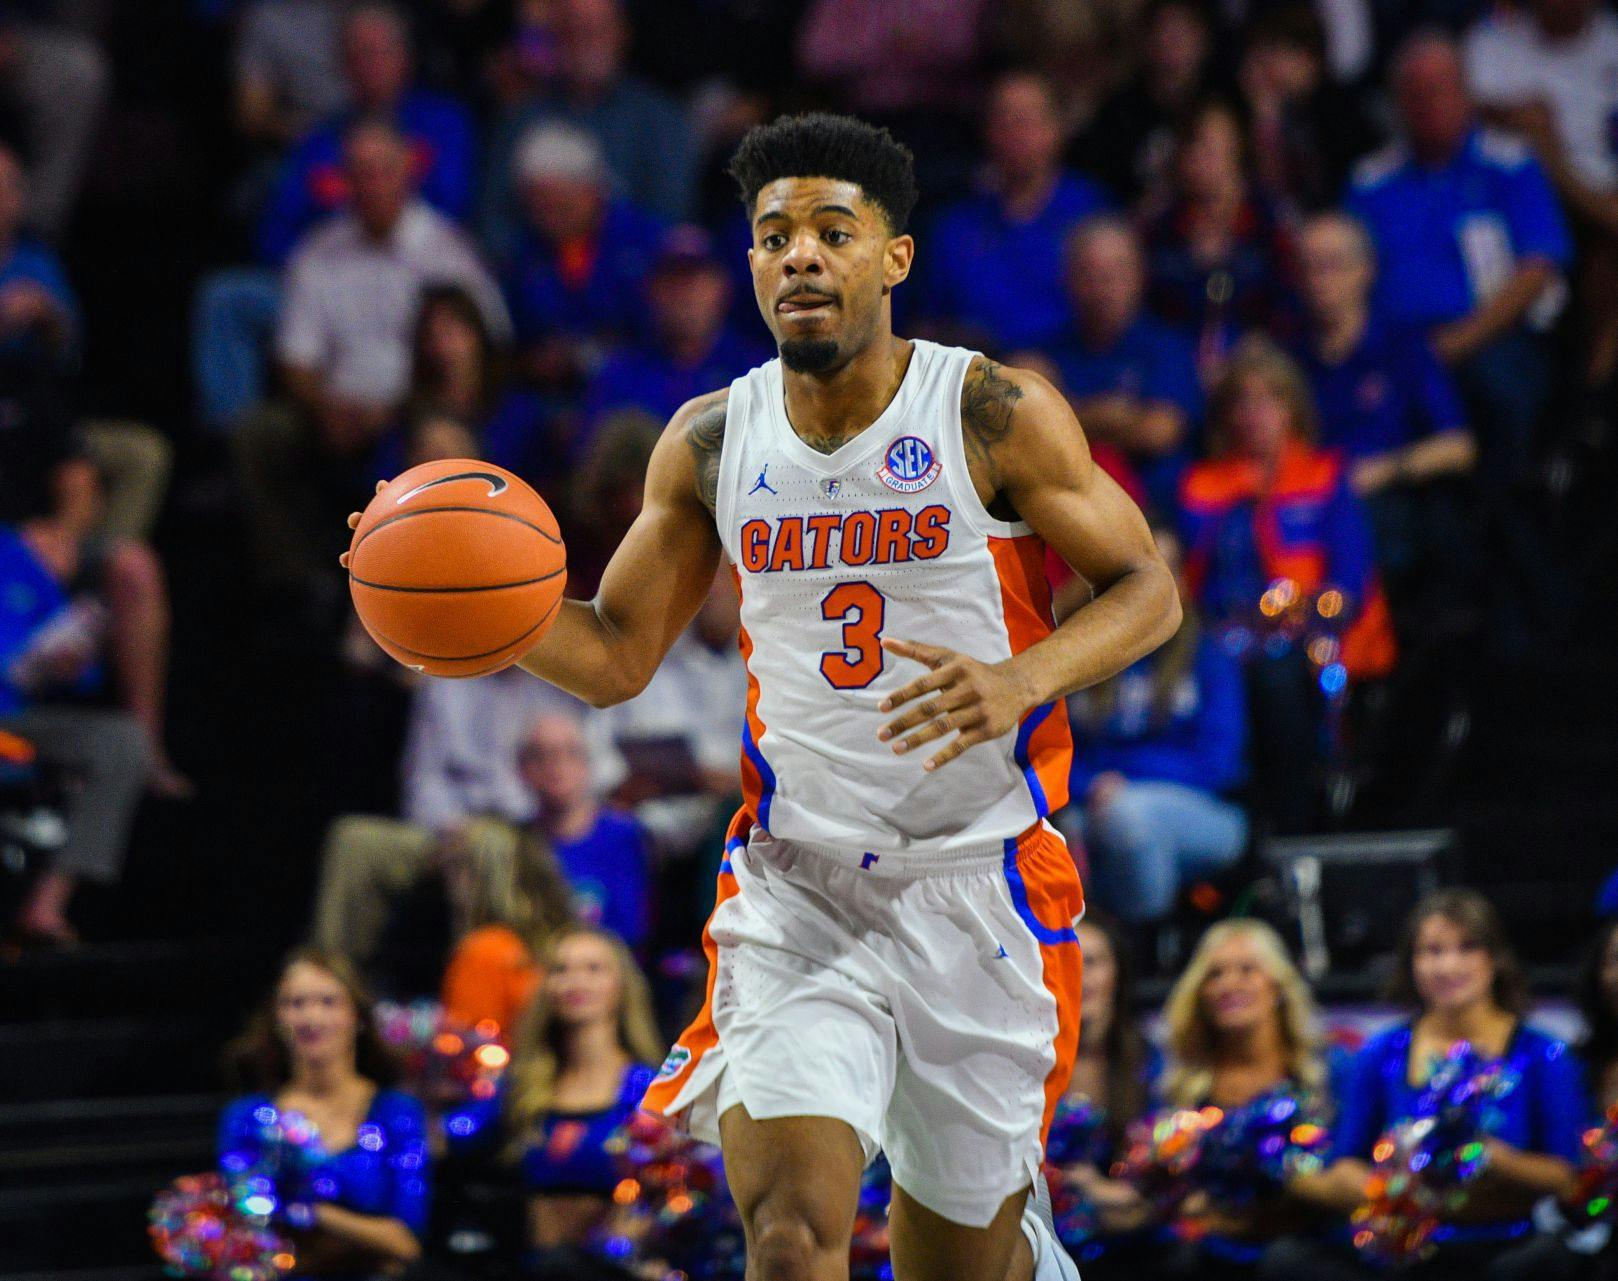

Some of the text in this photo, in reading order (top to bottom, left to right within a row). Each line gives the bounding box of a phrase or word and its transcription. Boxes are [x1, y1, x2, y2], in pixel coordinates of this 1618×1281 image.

[885, 472, 934, 491] GRADUATE
[890, 439, 929, 478] SEC
[740, 504, 951, 573] GATORS
[820, 580, 886, 690] 3
